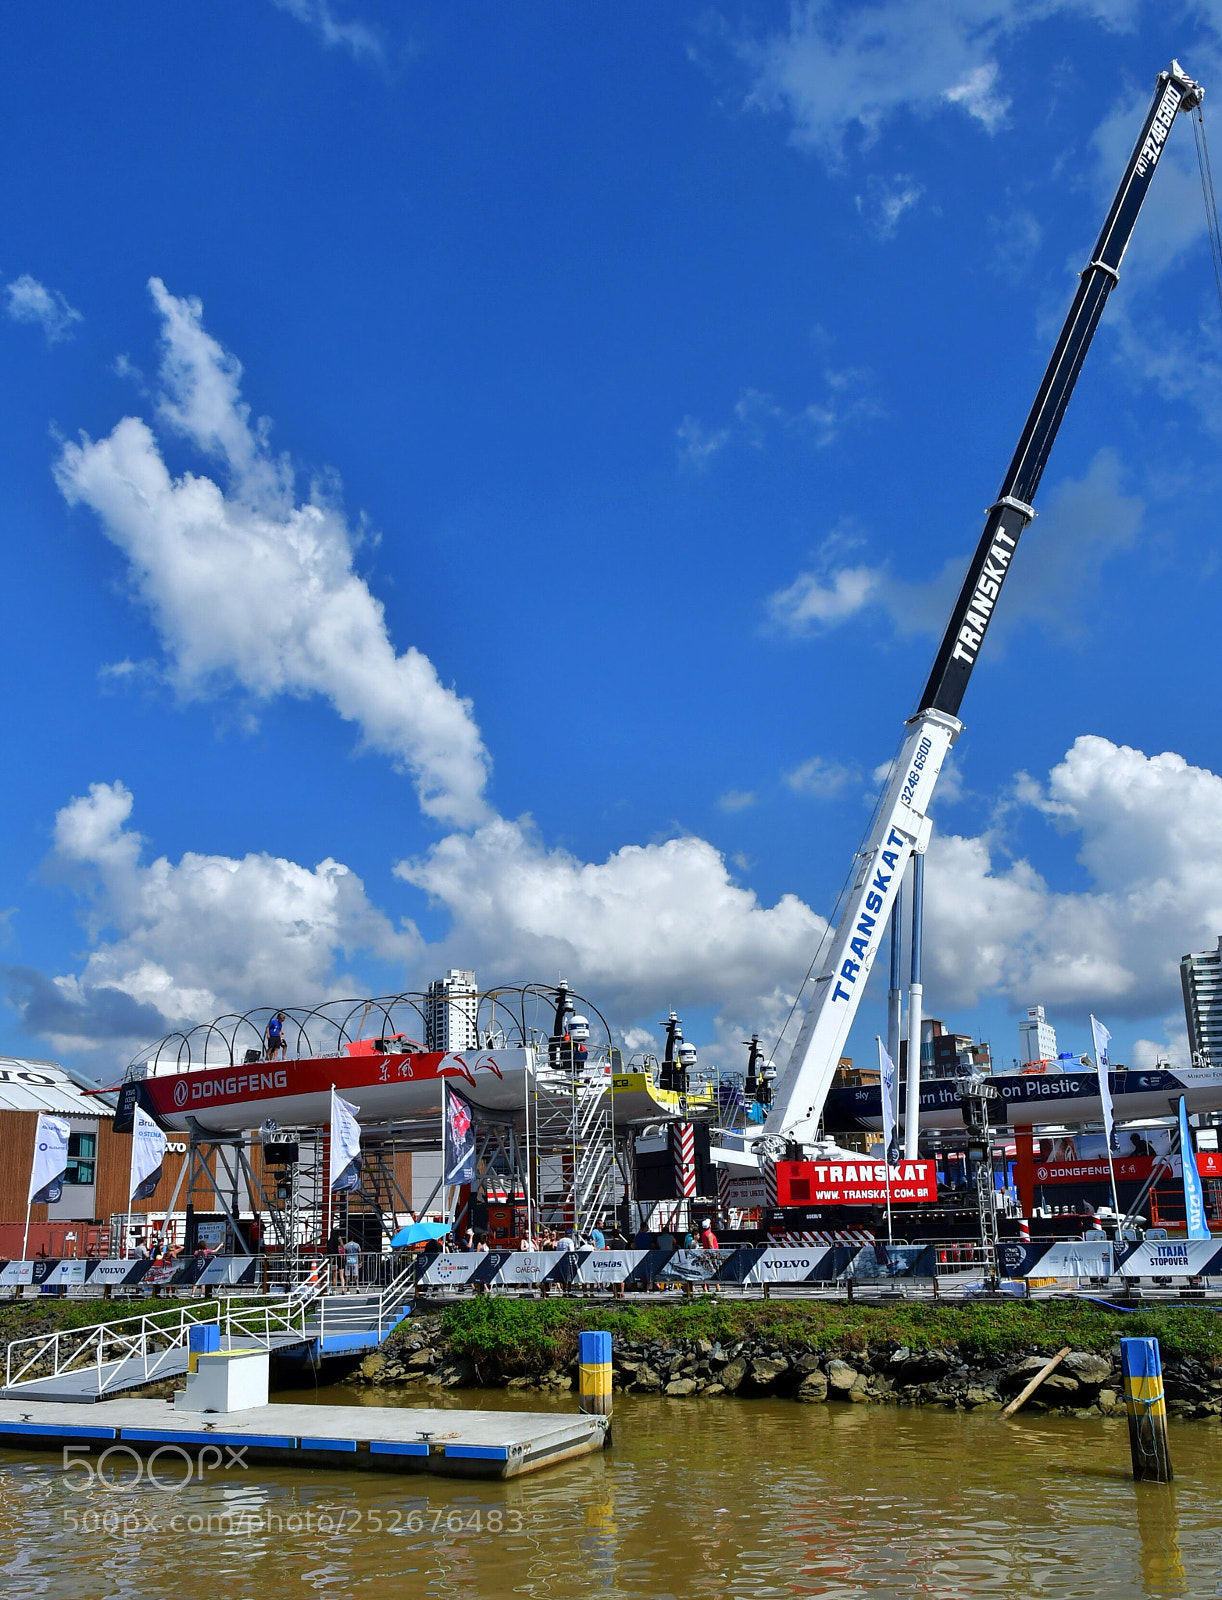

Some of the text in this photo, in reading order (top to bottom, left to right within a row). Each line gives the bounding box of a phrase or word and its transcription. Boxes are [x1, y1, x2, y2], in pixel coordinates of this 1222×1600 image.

[952, 525, 1016, 665] TRANSKAT
[831, 828, 904, 1002] TRANSKAT
[191, 1070, 287, 1100] DONGFENG
[855, 1088, 869, 1101] sky
[938, 1089, 962, 1103] the
[1001, 1085, 1021, 1098] on
[1025, 1079, 1080, 1097] Plastic
[814, 1164, 928, 1183] TRANSKAT
[1049, 1166, 1111, 1178] DONGFENG
[1157, 1243, 1188, 1257] ITAJAÍ
[592, 1260, 622, 1269] Vestas
[762, 1260, 810, 1271] VOLVO
[1149, 1256, 1189, 1267] STOPOVER
[99, 1267, 126, 1275] VOLVO
[515, 1266, 541, 1274] OMEGA
